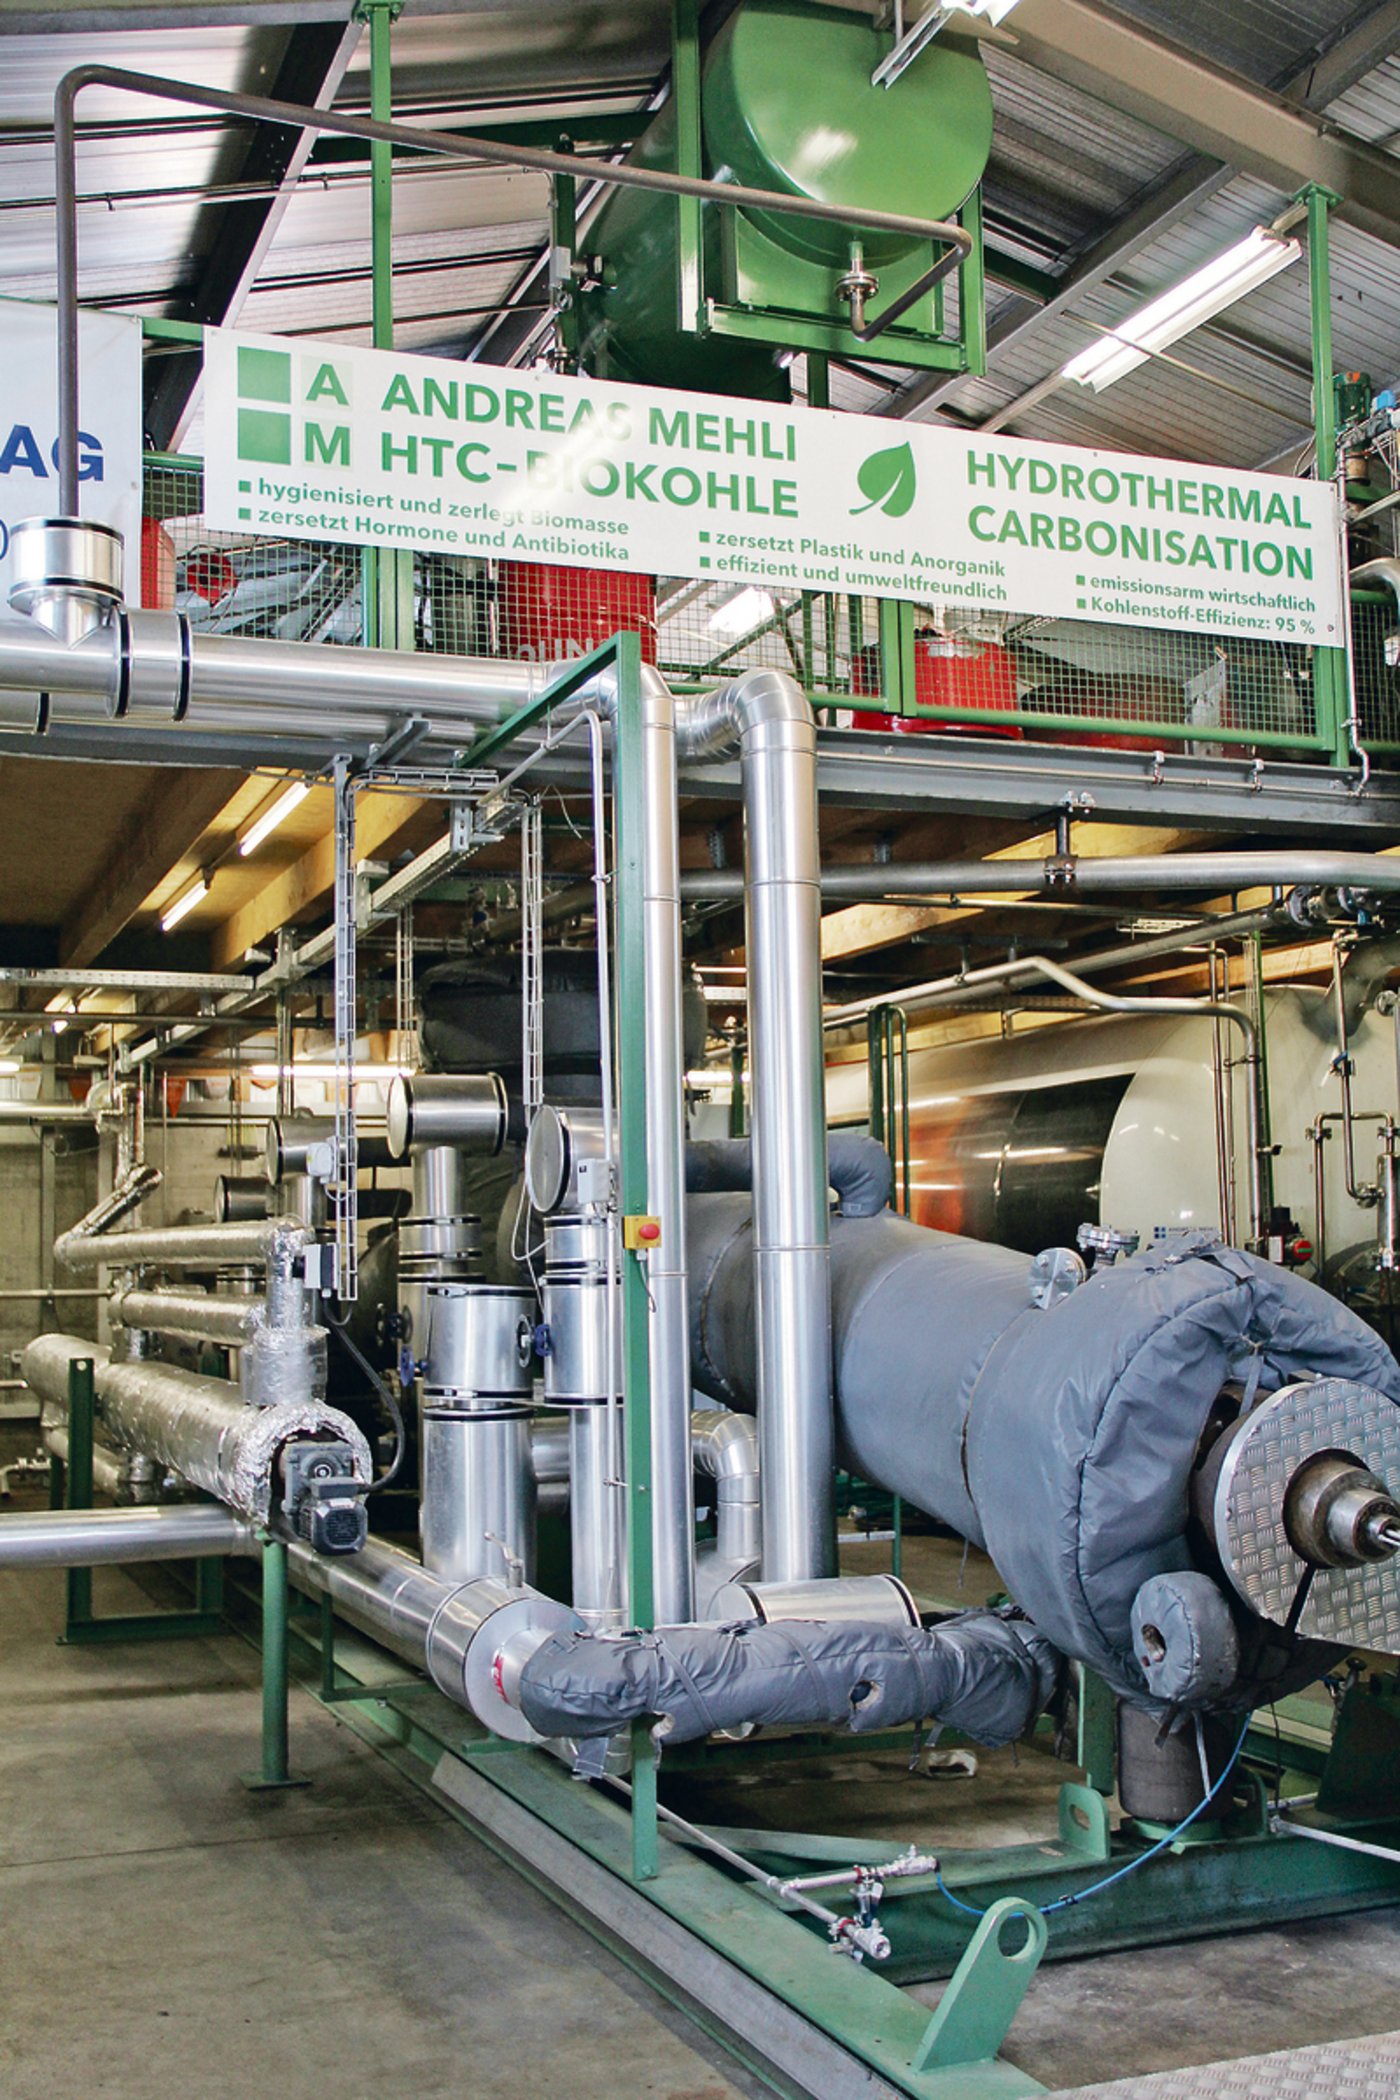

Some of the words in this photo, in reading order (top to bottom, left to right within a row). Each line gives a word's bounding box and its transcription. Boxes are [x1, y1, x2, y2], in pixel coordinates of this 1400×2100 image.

[306, 362, 350, 407] A
[380, 372, 633, 442] ANDREAS
[649, 406, 797, 462] MEHLI
[304, 420, 352, 468] M
[258, 477, 395, 509] hygienisiert
[399, 497, 442, 515] und
[531, 510, 629, 535] Biomasse
[967, 448, 1313, 530] HYDROTHERMAL
[257, 508, 350, 532] zersetzt
[354, 515, 459, 543] Hormone
[464, 531, 506, 548] und
[511, 532, 629, 561] Antibiotika
[716, 533, 796, 554] zersetzt
[800, 538, 863, 560] Plastik
[869, 548, 905, 565] und
[911, 550, 1006, 578] Anorganik
[968, 504, 1314, 582] CARBONISATION
[716, 556, 800, 578] effizient
[803, 563, 839, 582] und
[845, 568, 1008, 601] umweltfreundlich
[1090, 576, 1206, 600] emissionsarm
[1209, 588, 1317, 612] wirtschaftlich
[1092, 596, 1271, 630] Kohlenstoff-Effizienz:
[1275, 615, 1297, 633] 95
[1301, 620, 1316, 634] %
